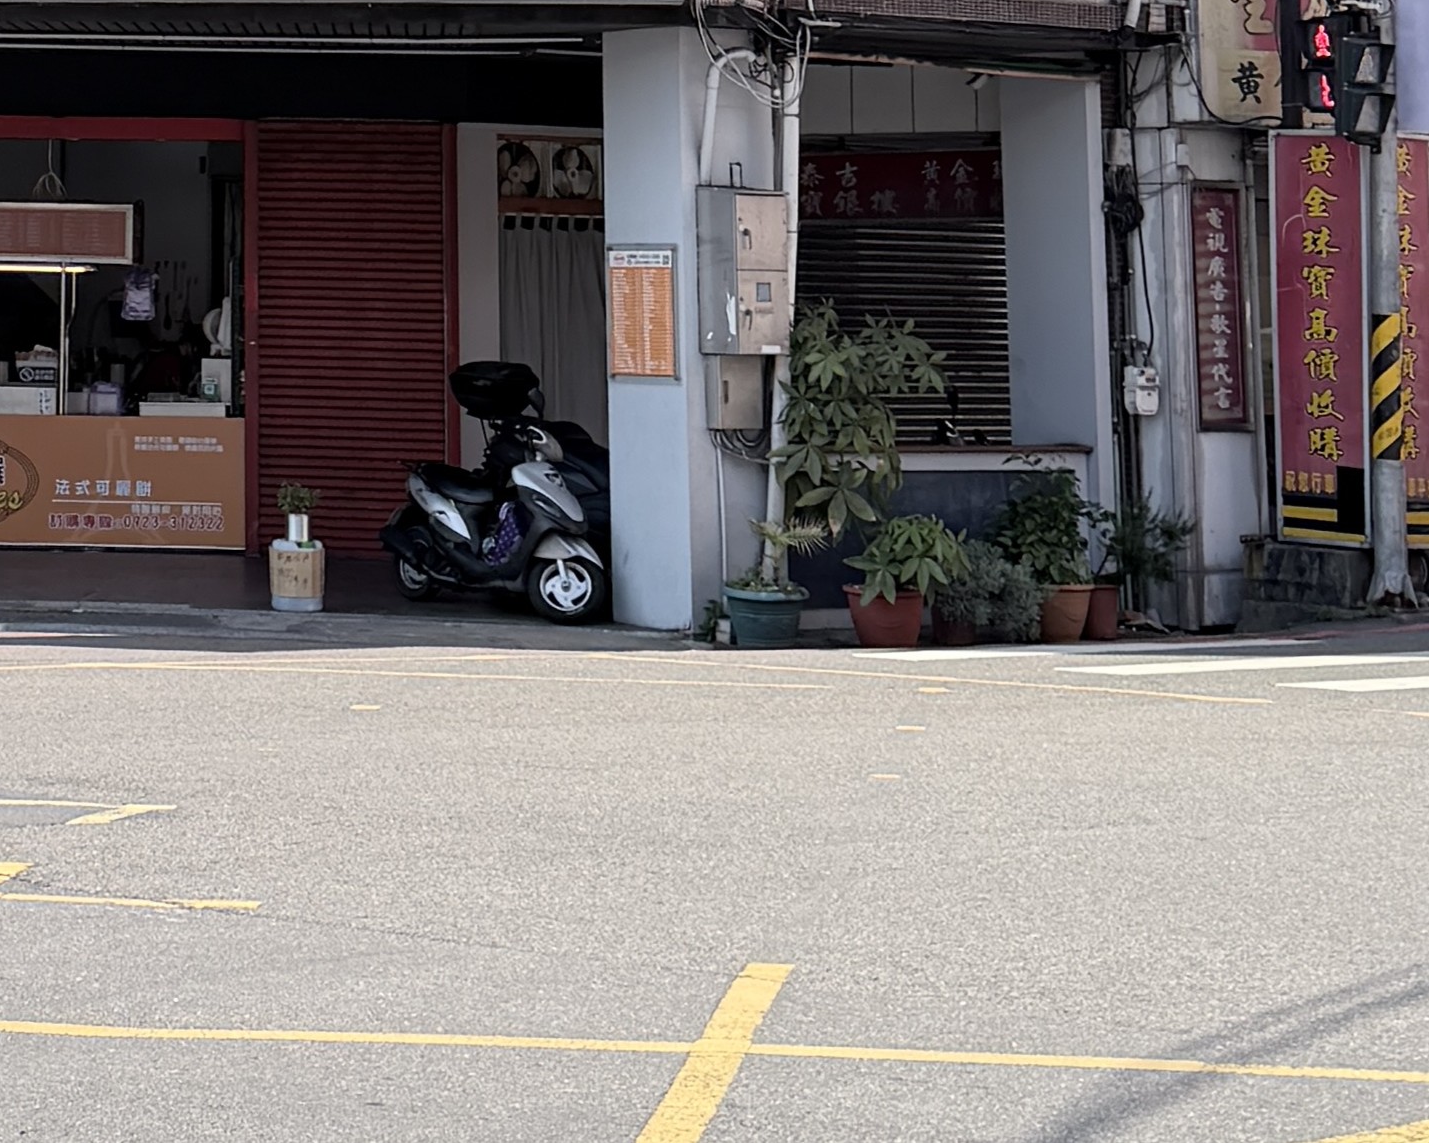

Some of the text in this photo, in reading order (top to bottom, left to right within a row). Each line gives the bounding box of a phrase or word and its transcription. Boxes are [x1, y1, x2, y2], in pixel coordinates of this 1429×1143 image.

[1300, 141, 1345, 462] 黃金珠寶高價收購
